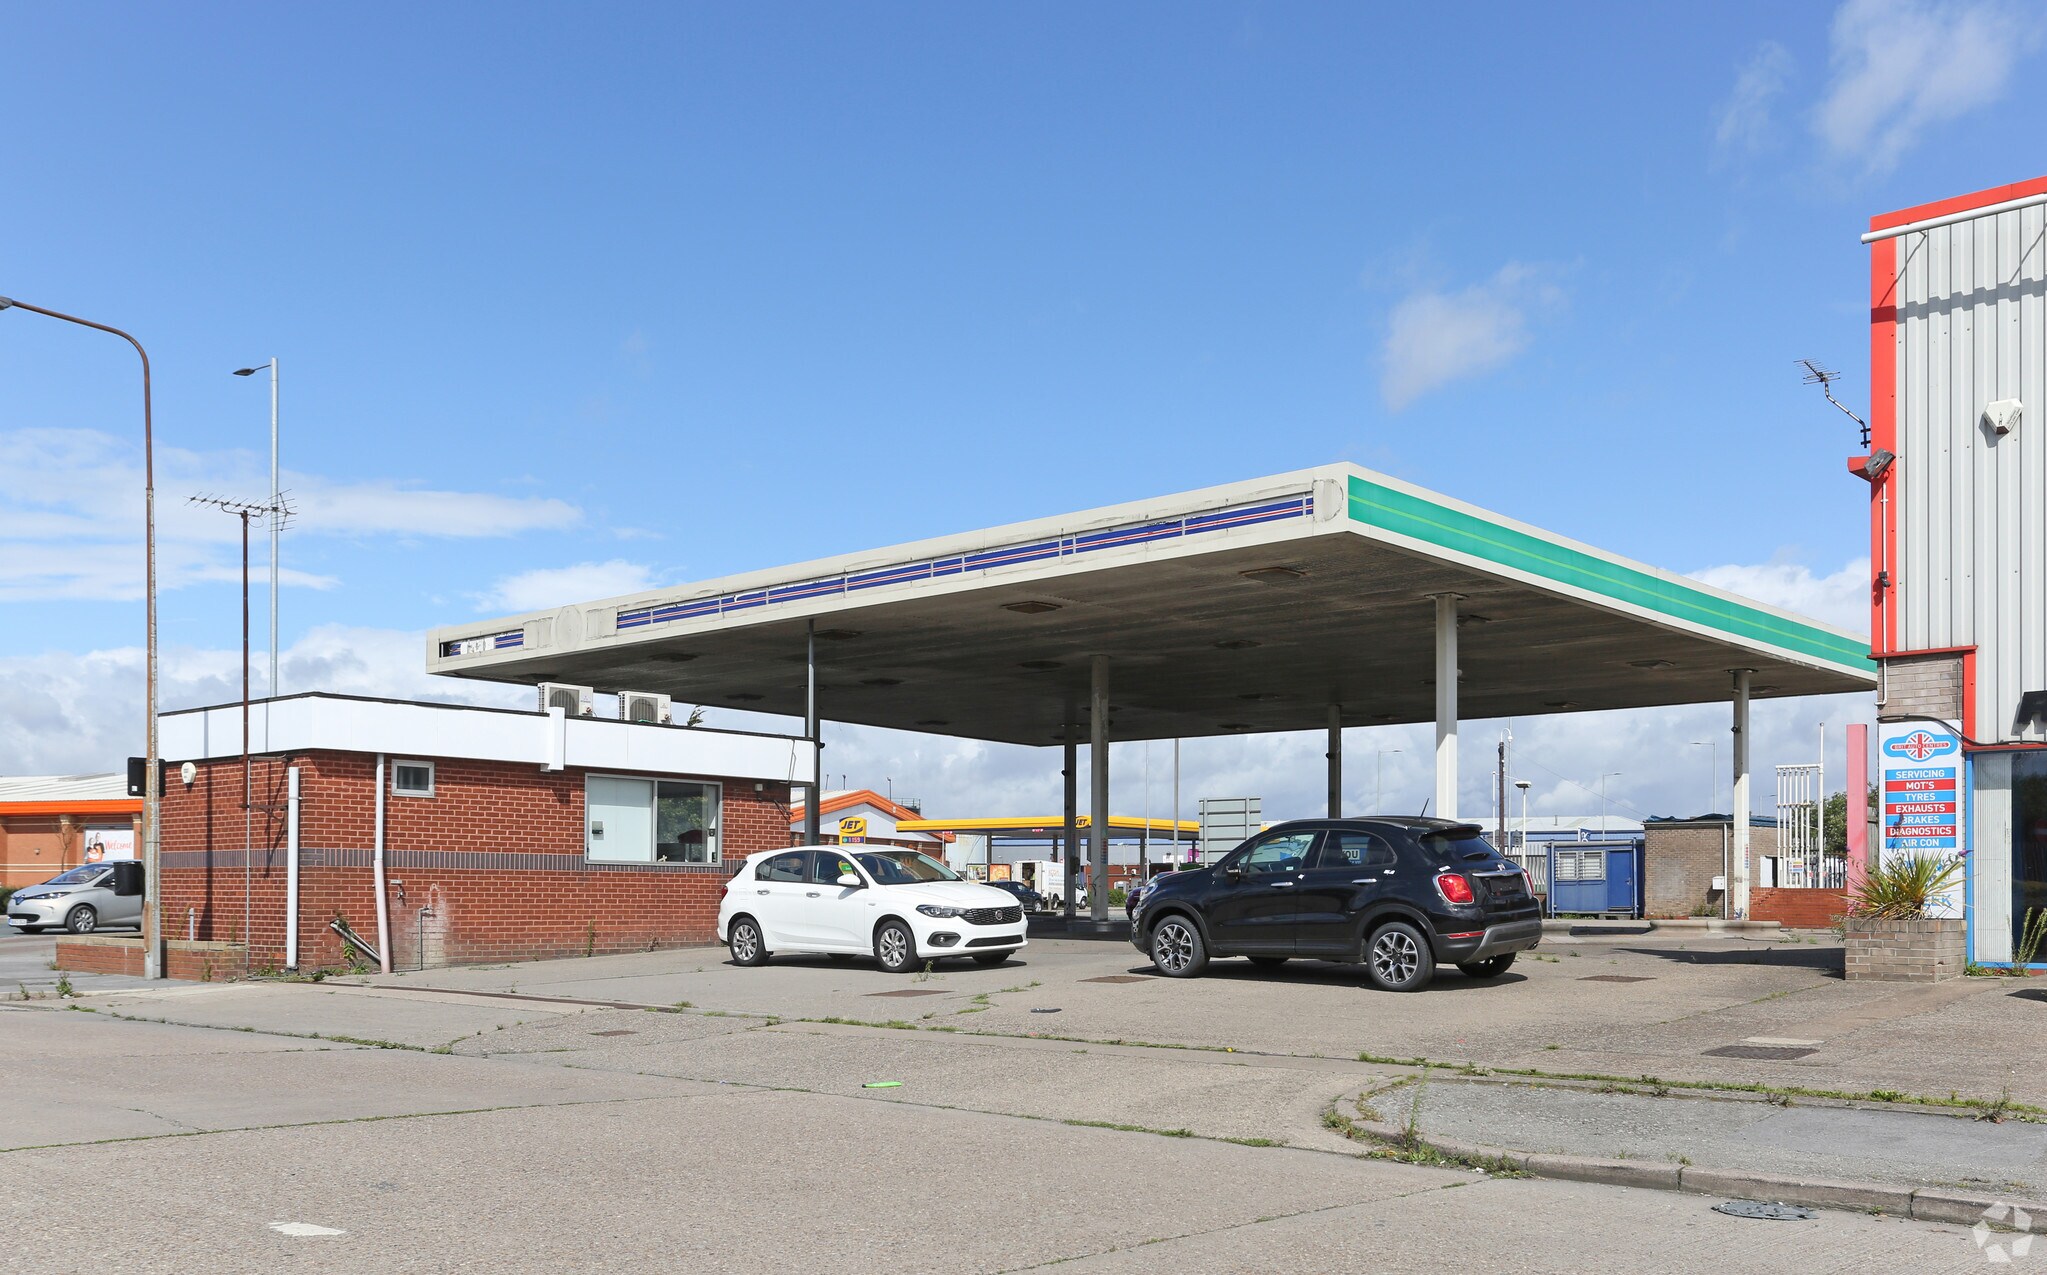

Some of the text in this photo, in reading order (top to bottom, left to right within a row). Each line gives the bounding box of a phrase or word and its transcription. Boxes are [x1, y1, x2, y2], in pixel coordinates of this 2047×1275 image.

[1895, 769, 1945, 779] SERVICING
[1905, 781, 1935, 790] MOT'S
[1905, 792, 1936, 801] TYRES
[1895, 803, 1946, 813] EXHAUSTS
[841, 820, 861, 829] JET
[1902, 815, 1940, 824] BRAKES
[1889, 826, 1952, 837] DIAGNOSTICS
[105, 840, 133, 851] Welcome
[1901, 837, 1940, 848] AIR CON
